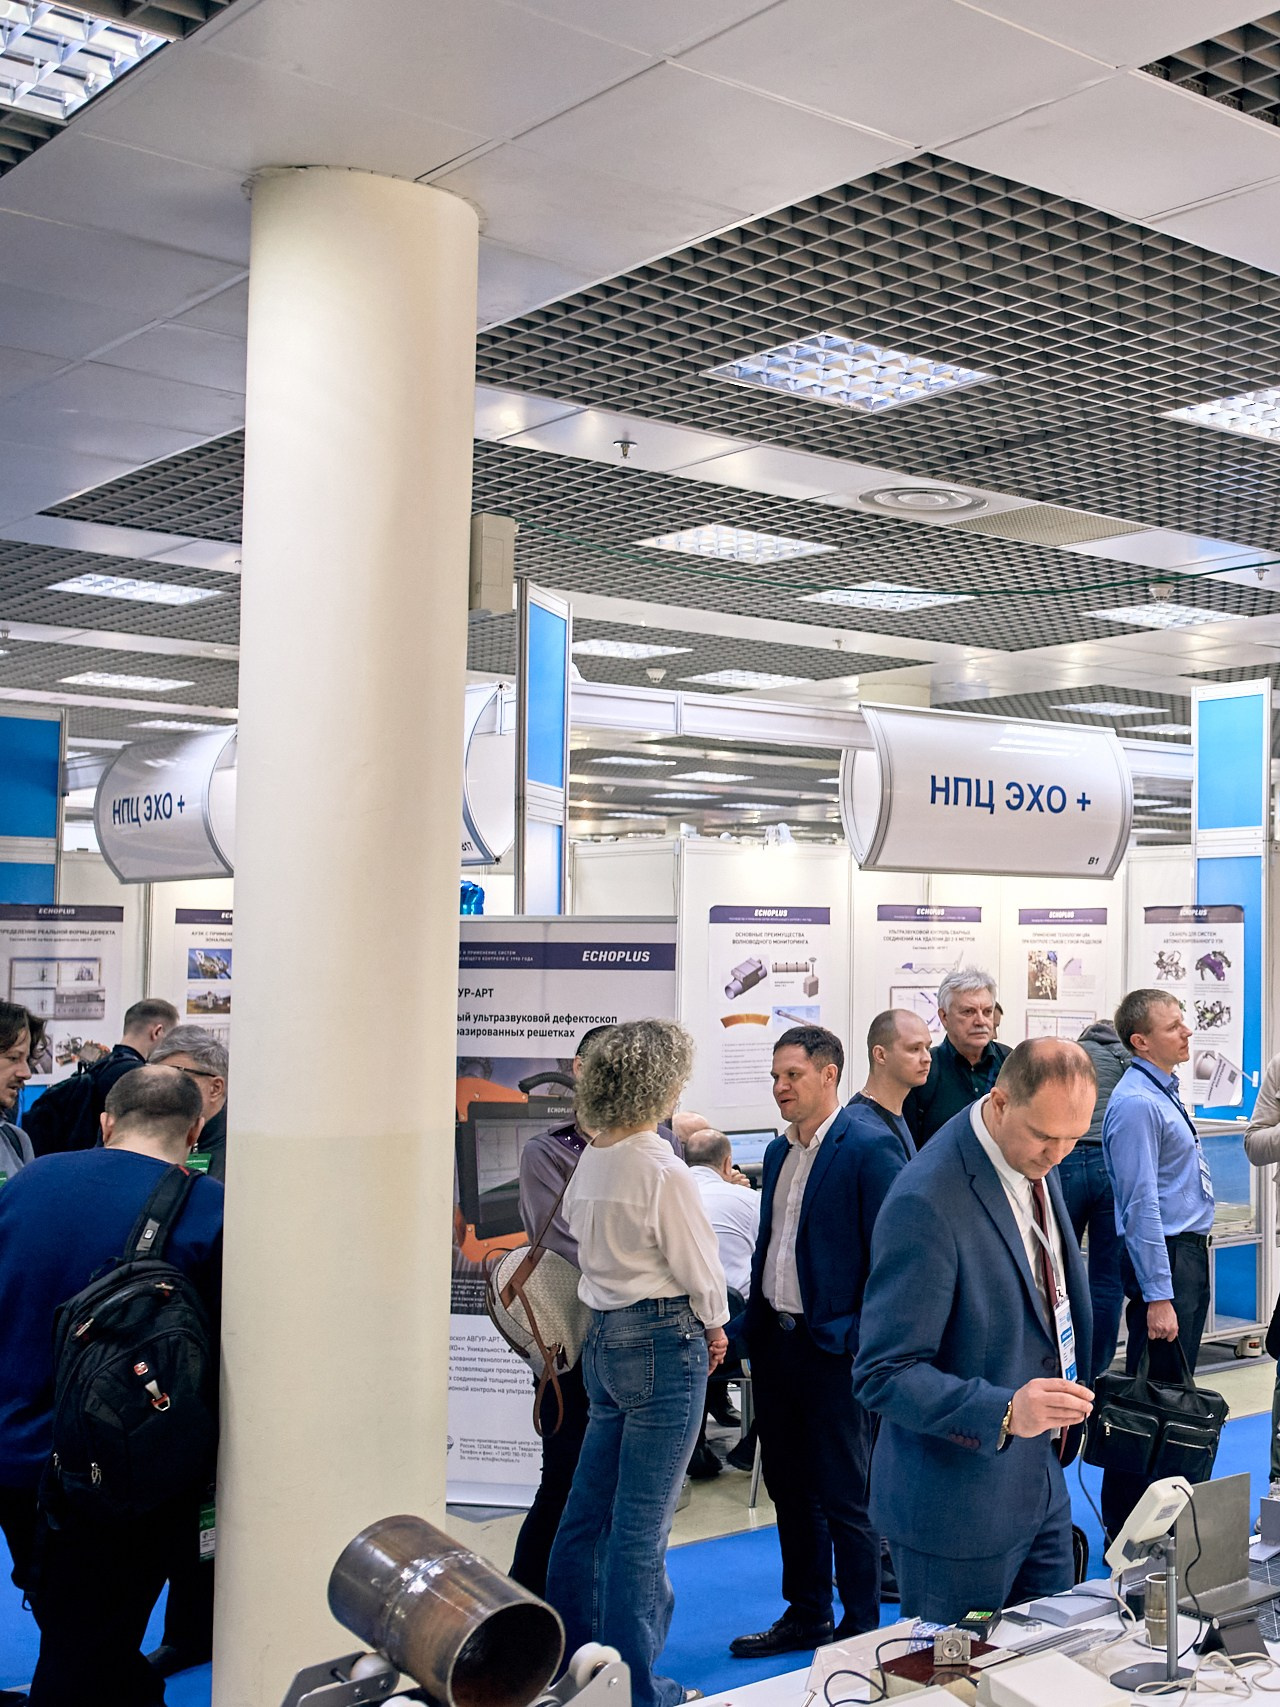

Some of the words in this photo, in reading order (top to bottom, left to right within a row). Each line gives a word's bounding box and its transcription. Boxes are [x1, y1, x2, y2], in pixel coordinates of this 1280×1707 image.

[930, 775, 995, 815] НПЦ
[1005, 782, 1067, 814] ЭХО
[113, 796, 142, 828] НПЦ
[144, 792, 172, 822] ЭХО
[754, 909, 788, 917] ECHOPLUS
[582, 950, 650, 962] ECHOPLUS
[458, 988, 494, 998] УР-АРТ
[458, 1013, 471, 1022] ый
[473, 1013, 550, 1024] ультразвуковой
[552, 1014, 617, 1025] дефектоскоп
[527, 1029, 575, 1038] решетках
